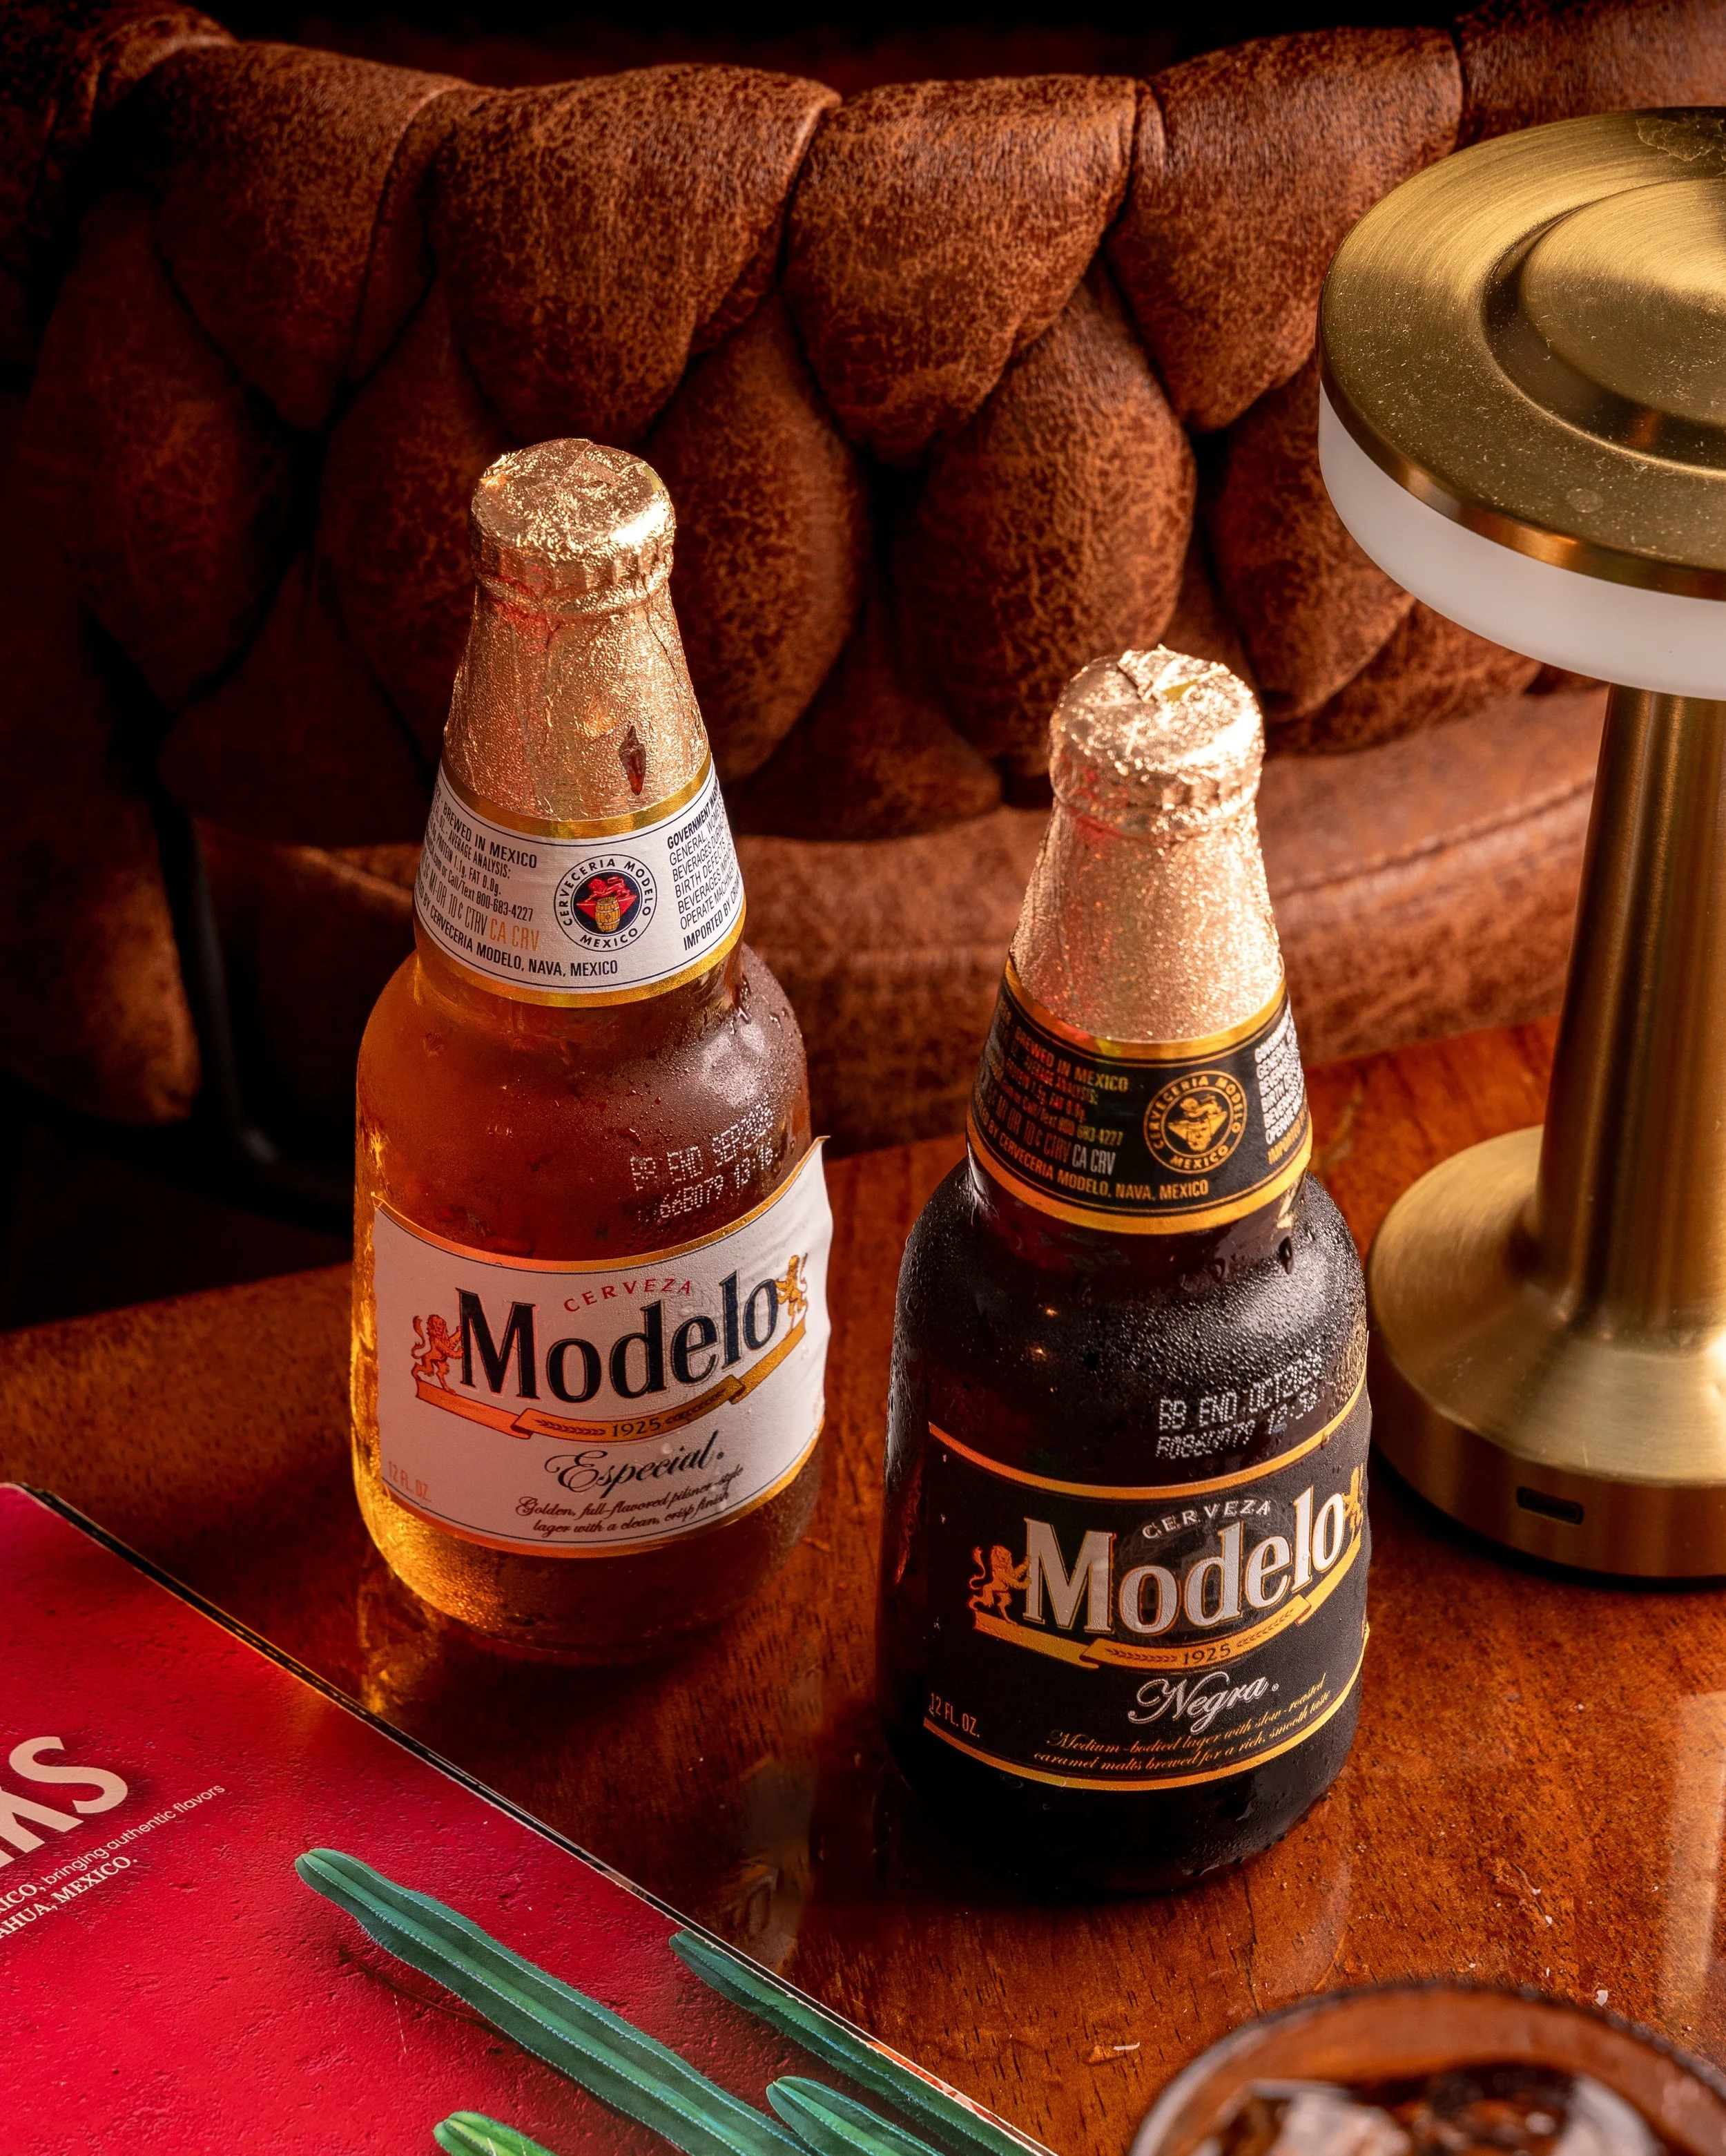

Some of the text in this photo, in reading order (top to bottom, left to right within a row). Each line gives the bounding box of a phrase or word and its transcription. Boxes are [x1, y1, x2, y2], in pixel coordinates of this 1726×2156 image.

[443, 802, 472, 842] BREWED
[475, 834, 485, 851] IN
[489, 842, 537, 868] MEXICO
[667, 802, 710, 849] GOVERNMENT
[670, 830, 708, 865] GENERAL,
[437, 831, 453, 863] PROTEIN
[469, 867, 481, 885] FAT
[482, 875, 501, 897] 0.0g.
[448, 829, 472, 860] AVERAGE
[473, 850, 511, 879] ANALYSIS:
[672, 841, 712, 882] BEVERAGES
[448, 869, 475, 902] Call/Text
[476, 891, 534, 923] 800-683-4227
[559, 858, 653, 926] CERVECERIA MODELO
[675, 871, 701, 898] BIRTH
[677, 868, 721, 914] BEVERAGES
[423, 892, 618, 976] BY CERVECERIA MODELO, NAVA, MEXICO
[465, 906, 488, 936] CTRV
[489, 918, 507, 944] CA
[512, 925, 540, 952] CRV
[680, 896, 715, 930] OPERATE
[683, 909, 723, 950] IMPORTED
[723, 898, 731, 916] BY
[580, 927, 638, 948] MEXICO
[1057, 1059, 1072, 1077] IN
[1074, 1066, 1129, 1093] MEXICO
[1149, 1075, 1208, 1149] CERVECERIA
[1215, 1077, 1243, 1133] MODELO
[666, 1146, 704, 1184] END
[1000, 1133, 1054, 1180] CERVECERIA
[1159, 1179, 1208, 1200] MEXICO
[1072, 1144, 1087, 1169] CA
[1090, 1148, 1116, 1176] CRV
[1170, 1145, 1228, 1169] MEXICO
[563, 1278, 691, 1312] CERVEZA
[456, 1269, 779, 1404] Modelo
[612, 1416, 661, 1437] 1925
[1159, 1398, 1187, 1430] BB
[1199, 1391, 1237, 1427] END
[389, 1461, 398, 1482] 12
[544, 1430, 719, 1499] Especial
[516, 1496, 576, 1516] Golden,
[574, 1492, 669, 1519] full-flavored
[1142, 1499, 1271, 1539] CERVEZA
[533, 1520, 572, 1538] lager
[574, 1519, 603, 1533] with
[1023, 1486, 1344, 1635] Modelo
[1182, 1644, 1232, 1666] 1925
[931, 1693, 980, 1738] 12 FL. OZ.
[1128, 1671, 1269, 1735] Negra
[1034, 1752, 1100, 1769] caramel
[1100, 1757, 1141, 1771] malts
[1145, 1751, 1201, 1770] brewed
[1198, 1749, 1221, 1767] for
[1224, 1746, 1234, 1755] a
[1269, 1705, 1308, 1739] smooth
[1182, 1733, 1221, 1751] lager
[1224, 1718, 1252, 1739] with
[41, 1847, 110, 1885] bringing
[106, 1809, 176, 1849] authentic
[173, 1784, 225, 1813] flavors
[50, 1855, 138, 1904] MEXICO.
